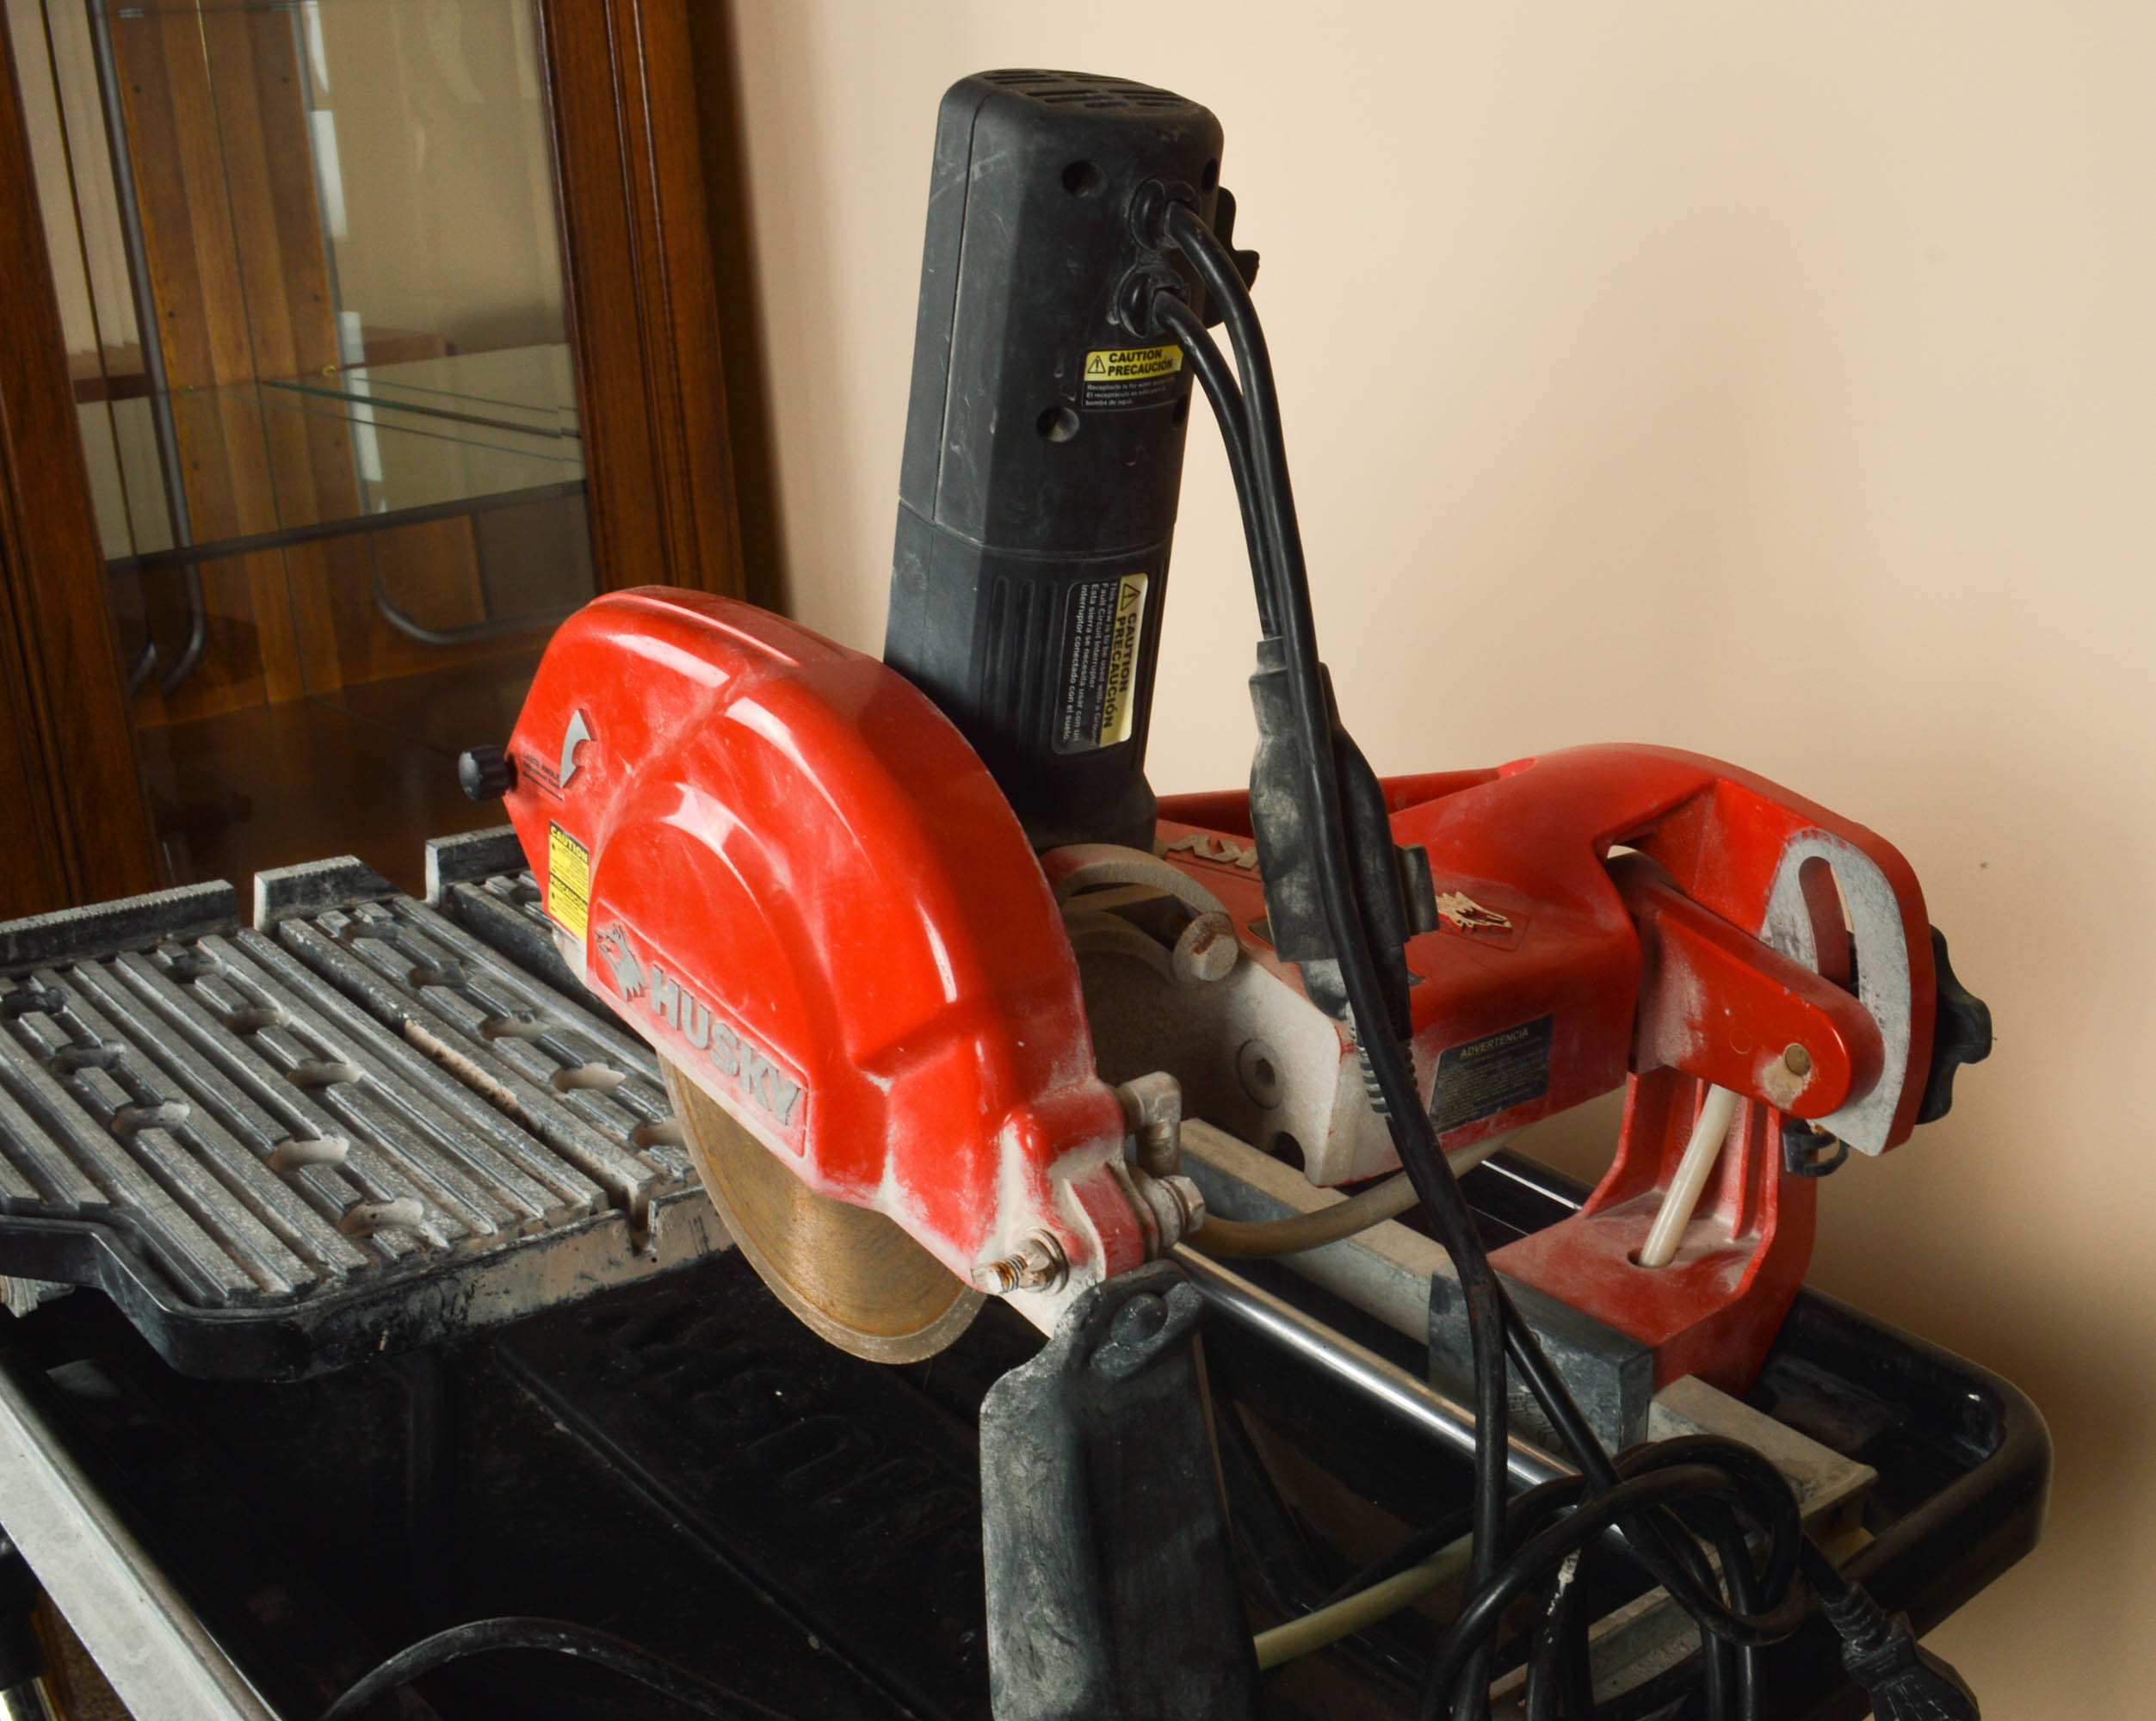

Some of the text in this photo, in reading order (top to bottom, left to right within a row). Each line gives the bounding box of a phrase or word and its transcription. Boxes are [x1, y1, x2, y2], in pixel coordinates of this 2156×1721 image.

[1109, 349, 1163, 363] CAUTION
[1090, 583, 1099, 604] Esta
[1098, 583, 1109, 607] Fault
[1086, 607, 1097, 633] sierra
[1095, 608, 1106, 638] Circuit
[1084, 635, 1091, 646] se
[1119, 613, 1137, 693] CAUTION
[1069, 636, 1082, 684] conectado
[1079, 648, 1090, 687] necesita
[1103, 617, 1127, 728] PRECAUCIÓN
[1067, 686, 1076, 703] con
[1077, 688, 1085, 708] usar
[1066, 705, 1074, 713] el
[1073, 729, 1080, 741] un
[651, 963, 802, 1126] HUSKY
[1460, 1027, 1529, 1059] ADVERTENCIA
